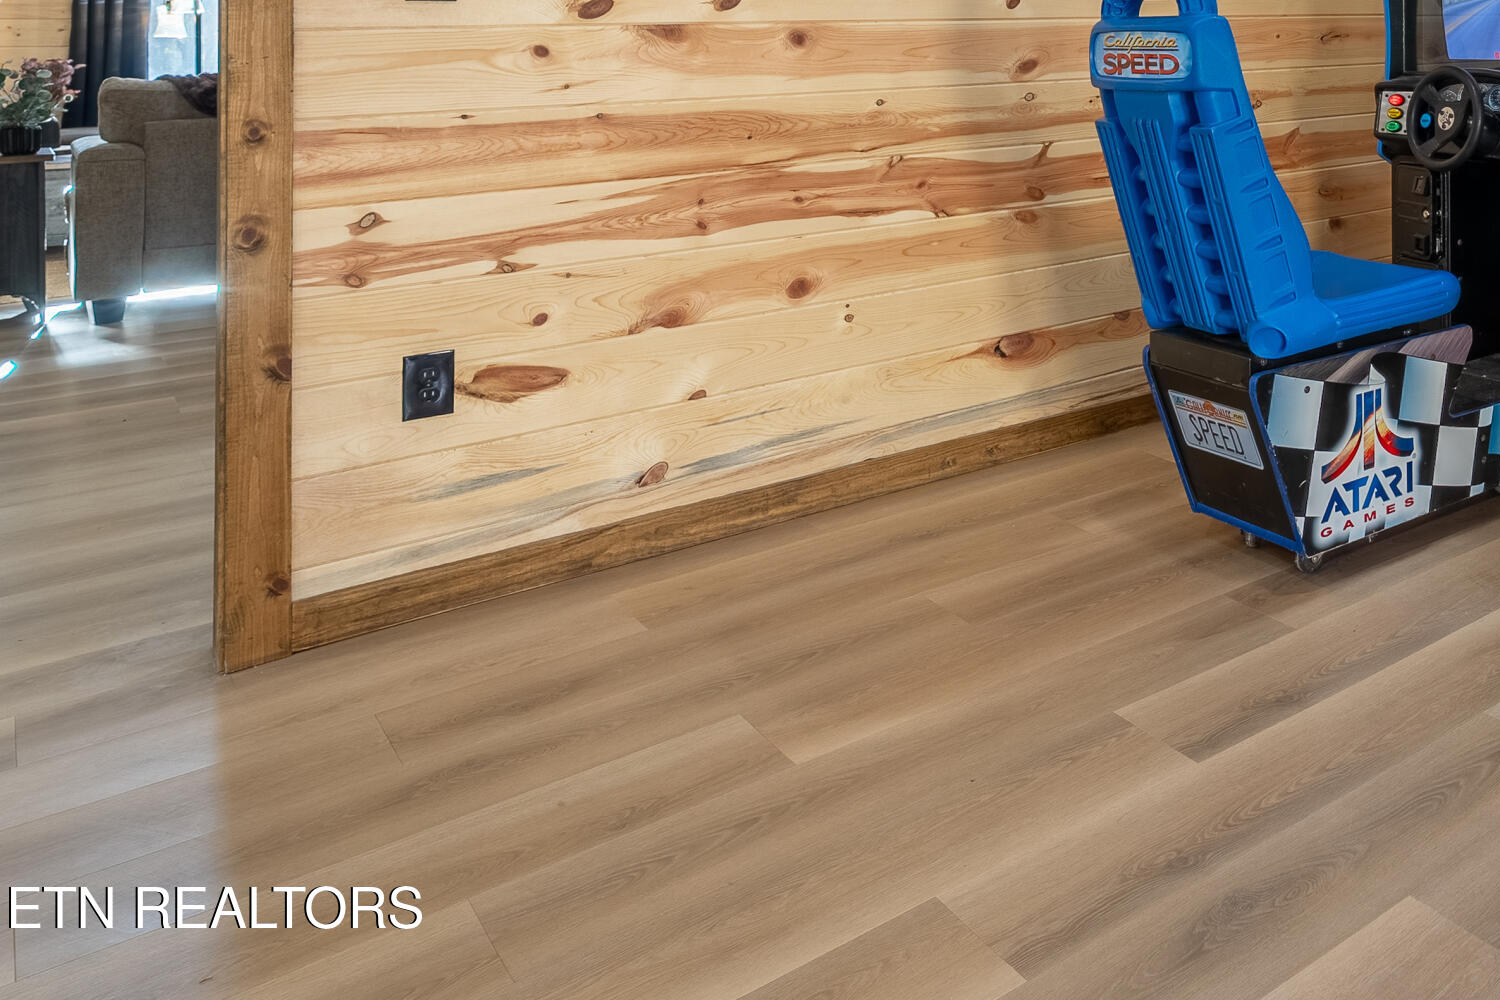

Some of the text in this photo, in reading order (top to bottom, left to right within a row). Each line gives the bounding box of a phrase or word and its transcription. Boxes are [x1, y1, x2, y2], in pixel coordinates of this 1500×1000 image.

[1103, 33, 1178, 53] California
[1103, 53, 1180, 75] SPEED
[1188, 413, 1245, 456] SPEED
[1321, 460, 1414, 524] ATARI
[1320, 497, 1414, 538] GAMES
